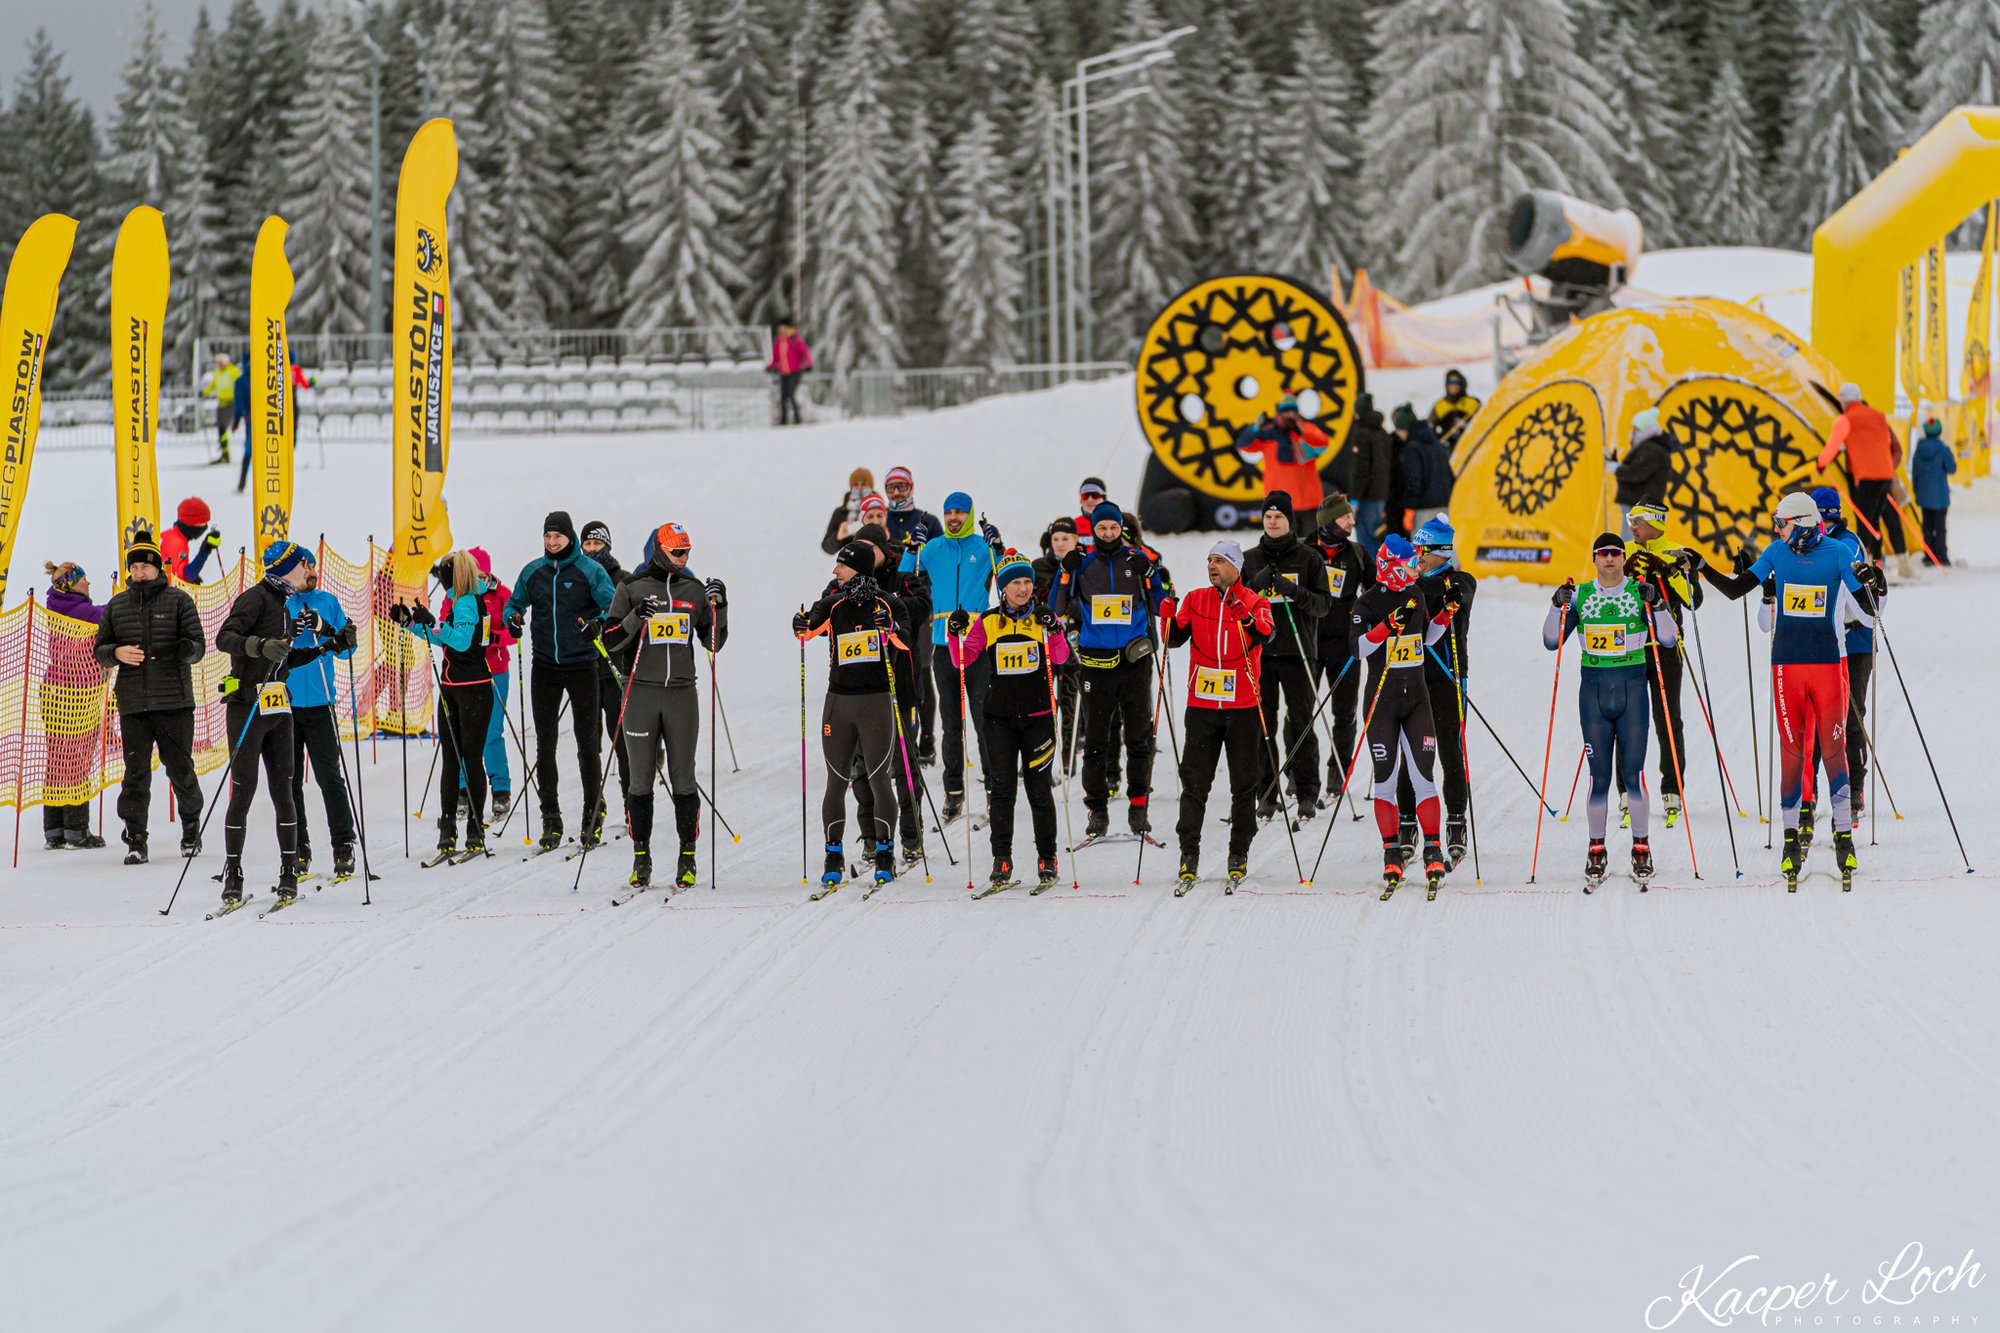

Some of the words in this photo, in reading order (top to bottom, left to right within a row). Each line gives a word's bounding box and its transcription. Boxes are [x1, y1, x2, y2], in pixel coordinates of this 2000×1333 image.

[425, 322, 443, 446] JAKUSZYCE
[1791, 597, 1807, 610] 74
[1103, 606, 1112, 618] 6
[656, 625, 674, 637] 20
[1592, 636, 1607, 650] 22
[845, 643, 862, 657] 66
[1396, 648, 1409, 661] 12
[1003, 655, 1023, 668] 111
[1202, 680, 1216, 693] 71
[264, 693, 284, 708] 121
[1777, 677, 1787, 716] SZKLARSKA
